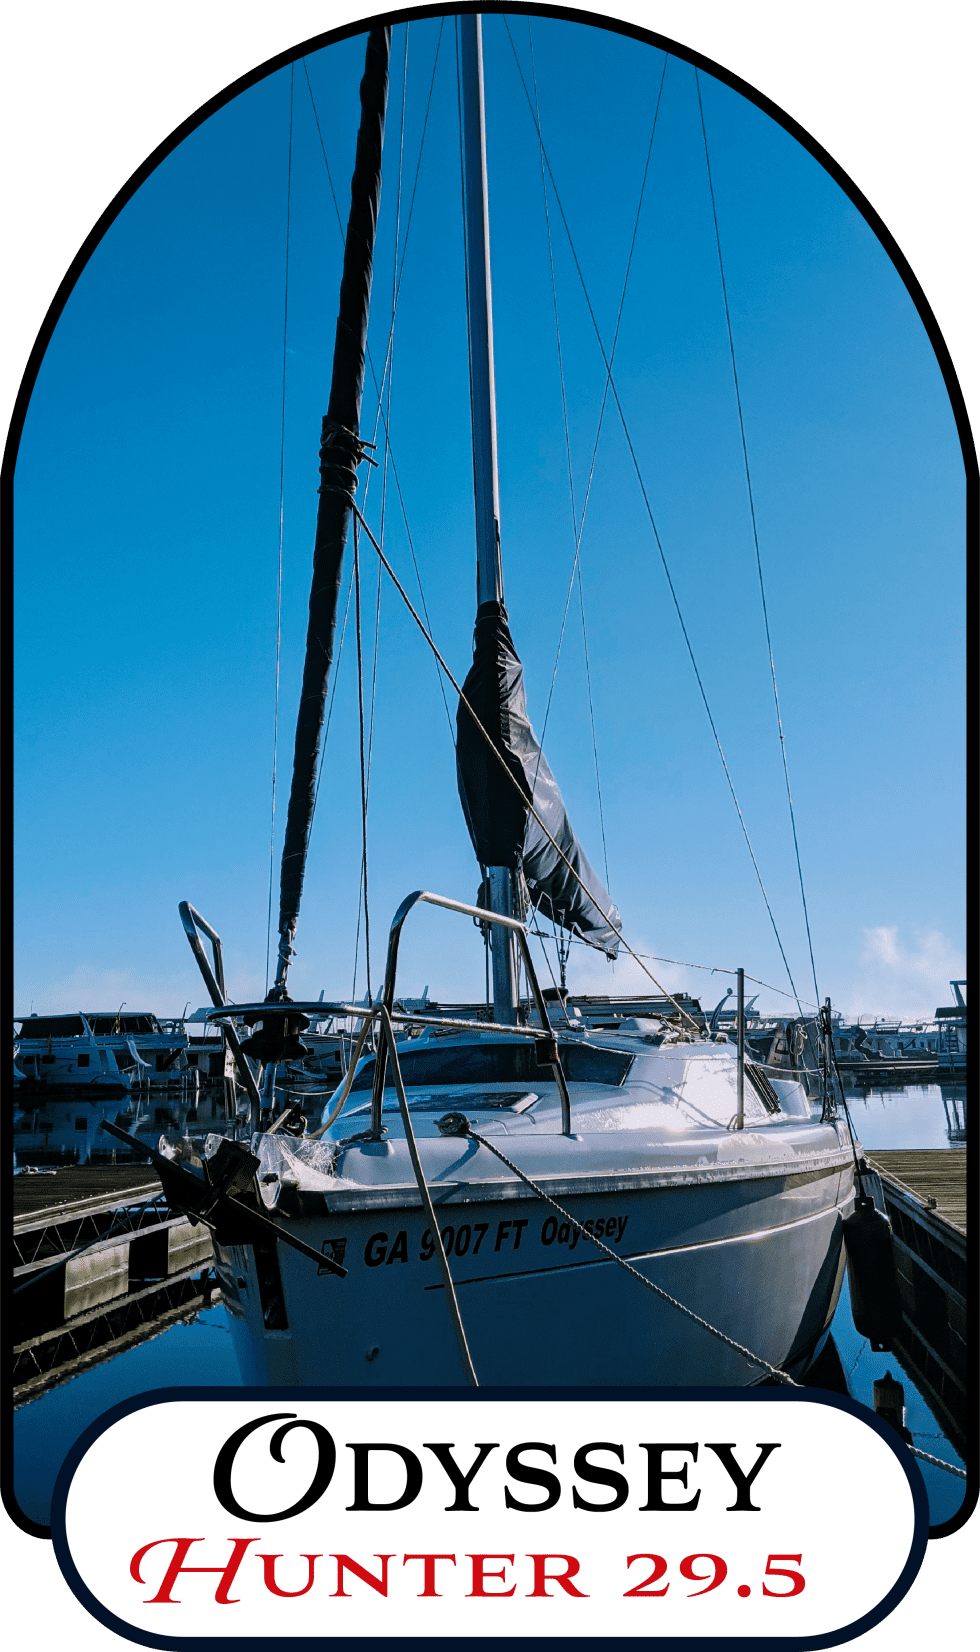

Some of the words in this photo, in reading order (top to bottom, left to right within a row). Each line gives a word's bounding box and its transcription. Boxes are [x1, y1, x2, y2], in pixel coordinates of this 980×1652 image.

[363, 1230, 409, 1268] GA
[419, 1222, 490, 1262] 9007
[494, 1218, 529, 1253] FT
[540, 1214, 629, 1251] Odyssey
